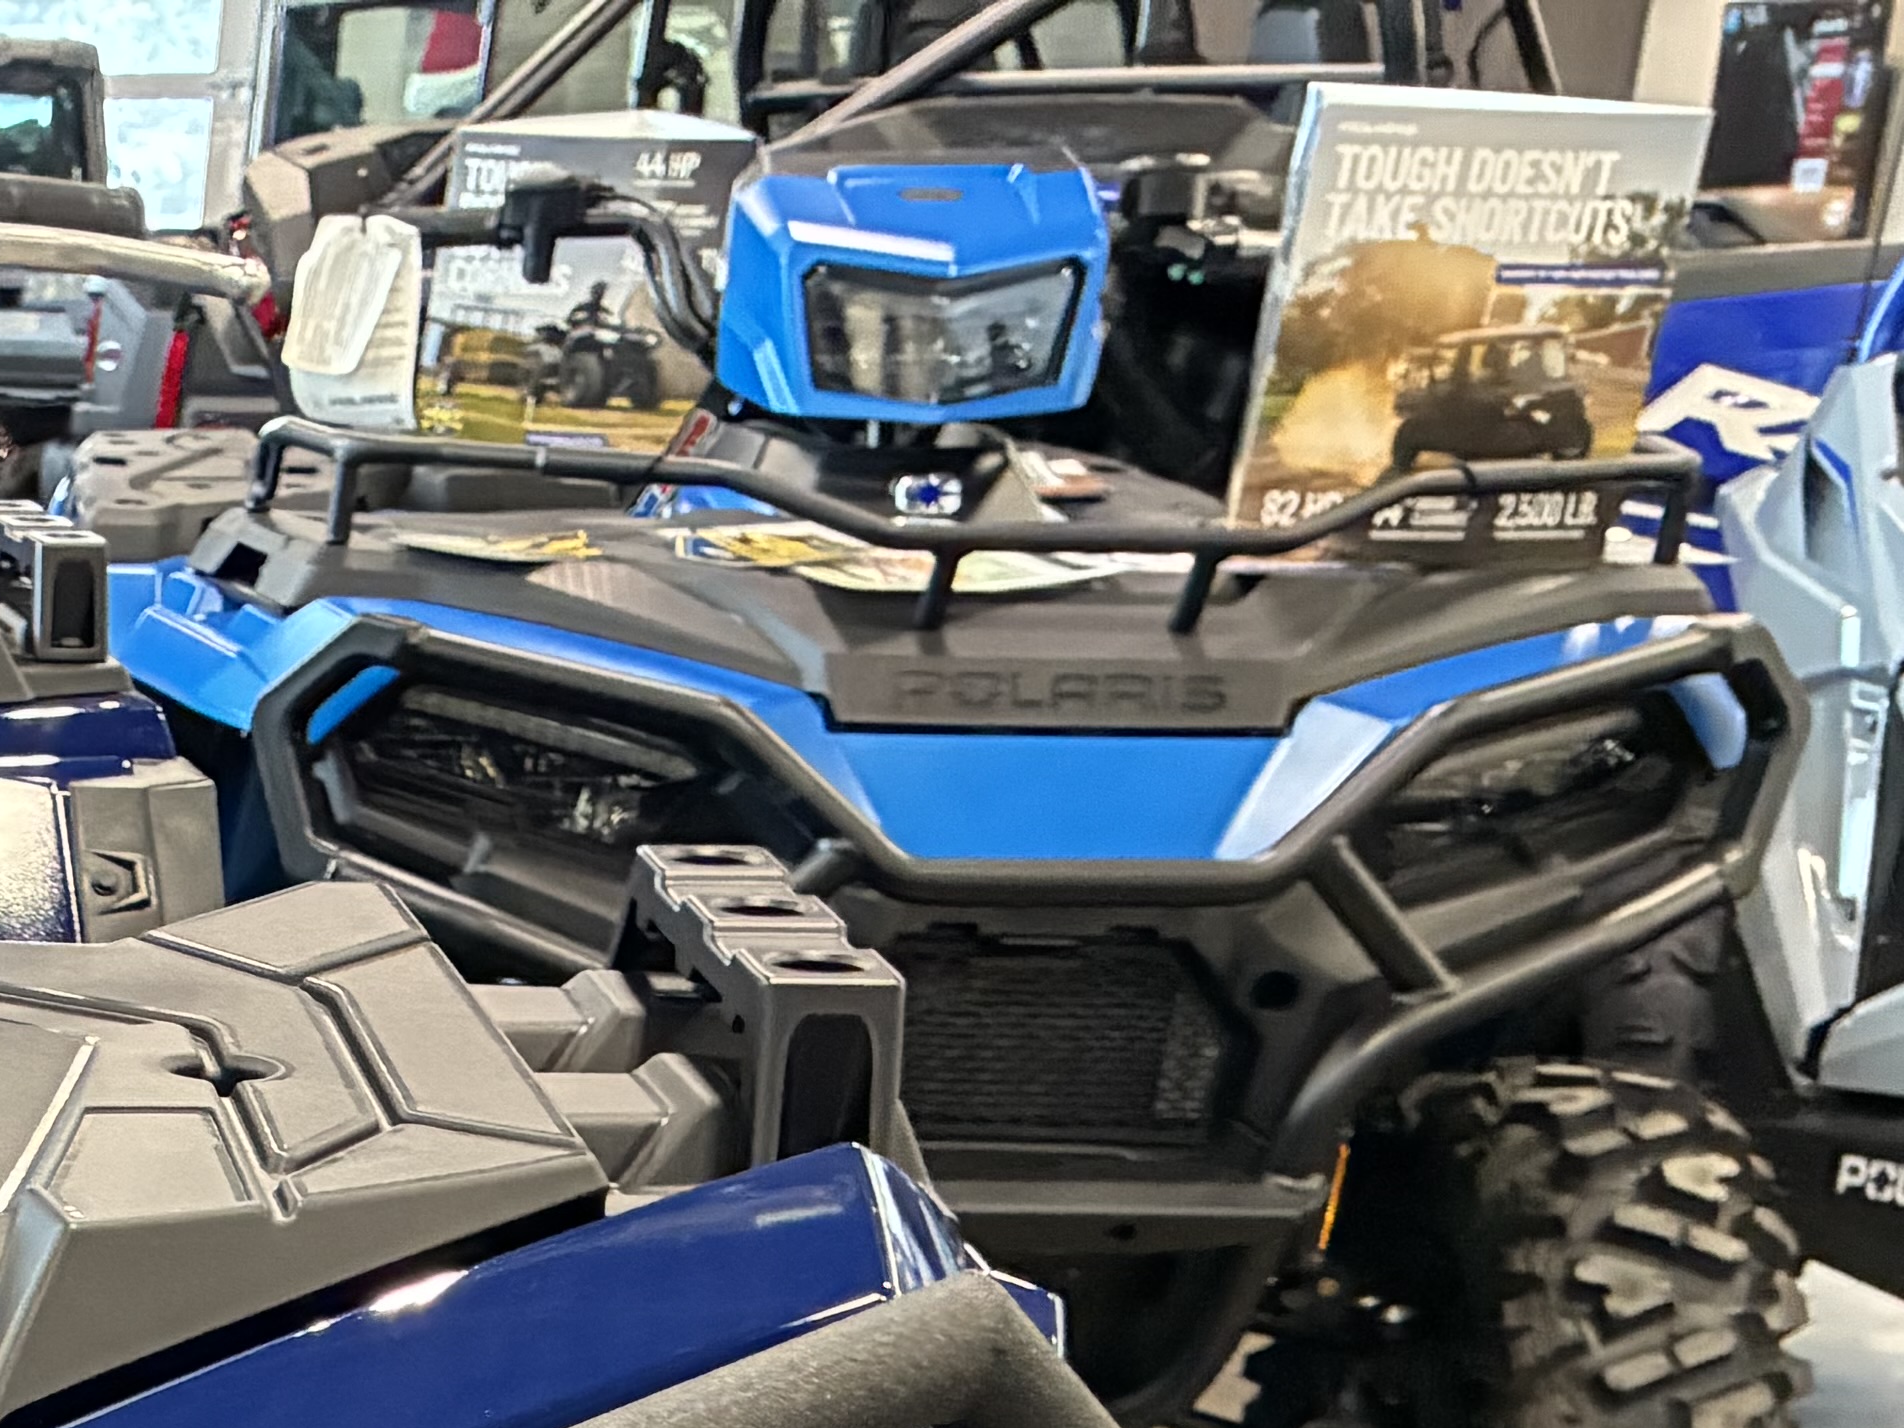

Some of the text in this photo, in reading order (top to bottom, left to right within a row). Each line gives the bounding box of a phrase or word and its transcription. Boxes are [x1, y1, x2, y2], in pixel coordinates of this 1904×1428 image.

[1335, 144, 1621, 197] TOUGH DOESN'T
[1324, 192, 1633, 246] TAKE SHORTCUTS
[896, 669, 1229, 715] POLARIS
